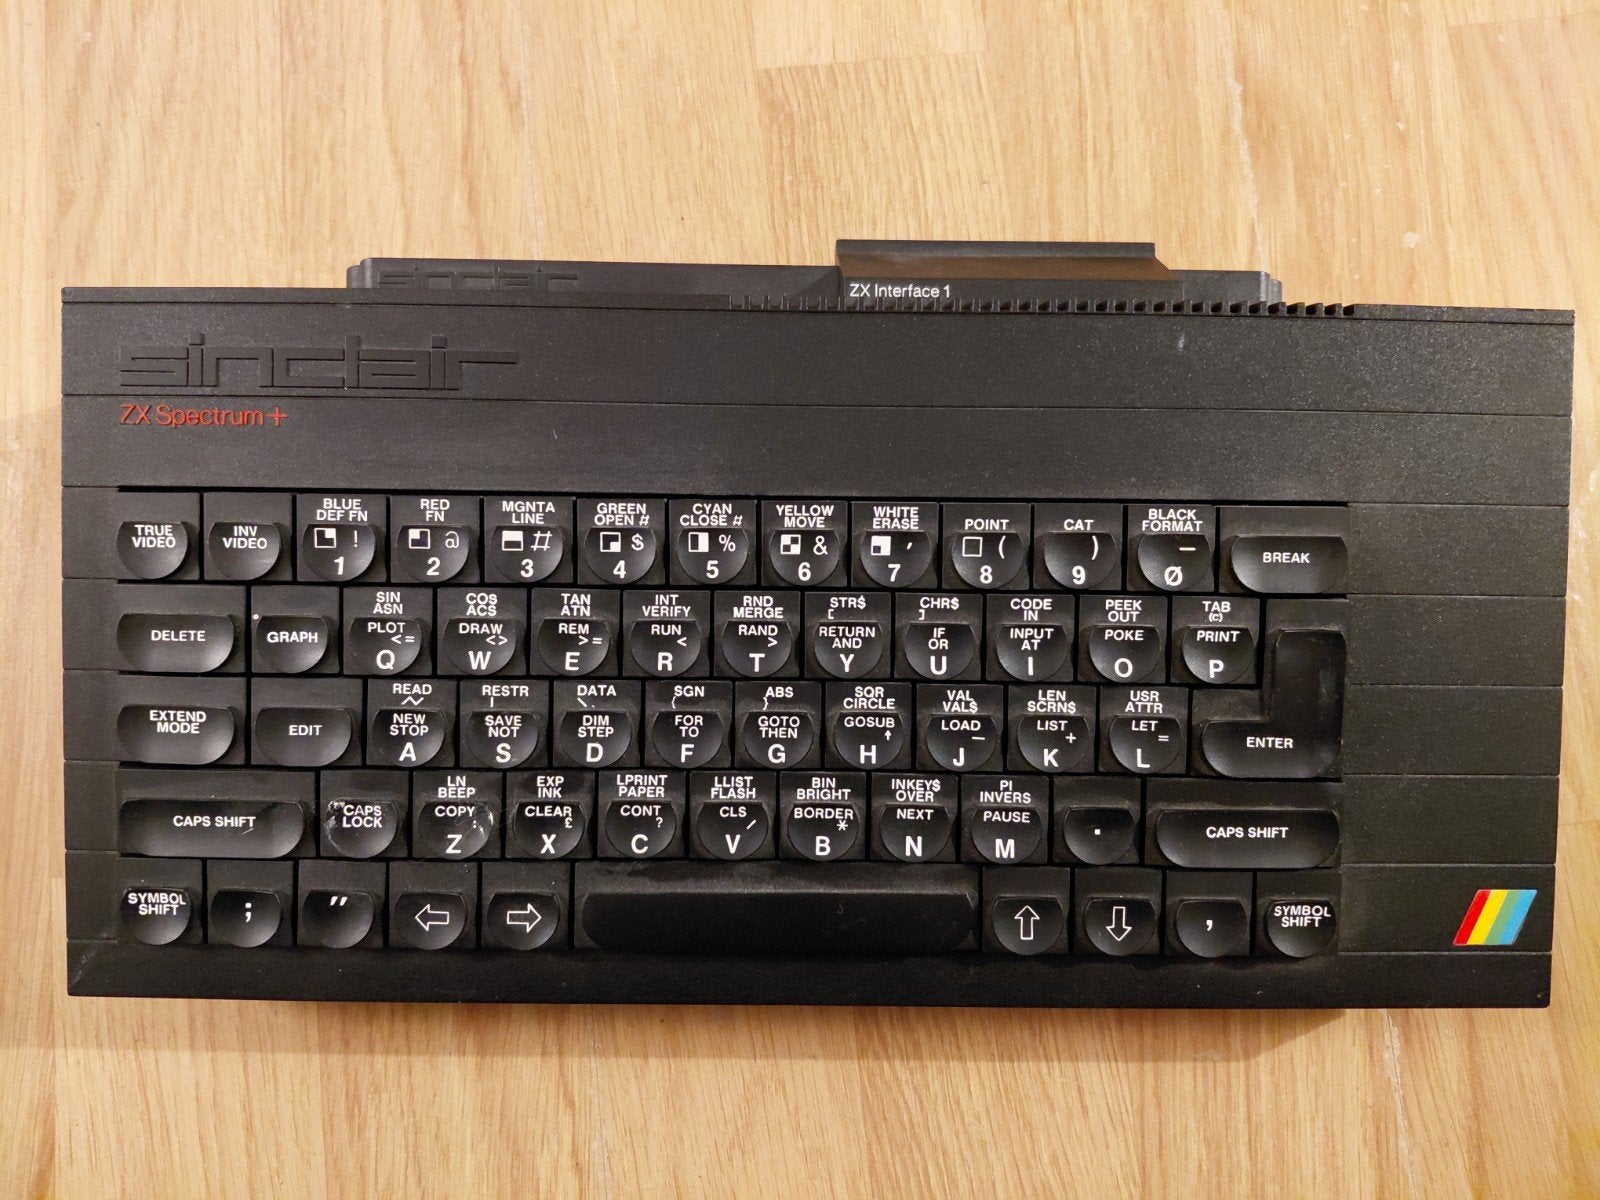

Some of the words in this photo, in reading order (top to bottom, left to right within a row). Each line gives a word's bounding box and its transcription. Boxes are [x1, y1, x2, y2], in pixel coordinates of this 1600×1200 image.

[850, 284, 870, 297] ZX
[875, 284, 939, 297] Interface
[944, 285, 949, 297] 1
[119, 334, 517, 389] sinclair
[121, 404, 150, 424] ZX
[157, 405, 264, 426] Spectrum
[324, 498, 361, 510] BLUE
[421, 499, 450, 510] RED
[503, 501, 555, 512] MGNTA
[596, 503, 646, 515] GREEN
[317, 509, 346, 521] DEF
[349, 510, 367, 521] FN
[426, 510, 444, 521] FN
[693, 504, 731, 516] CYAN
[776, 505, 834, 518] YELLOW
[874, 506, 918, 519] WHITE
[1149, 509, 1196, 520] BLACK
[512, 513, 544, 524] LINE
[595, 513, 634, 525] OPEN
[680, 515, 727, 526] CLOSE
[784, 516, 825, 528] MOVE
[873, 517, 918, 529] ERASE
[965, 519, 1009, 530] POINT
[1064, 519, 1093, 530] CAT
[1142, 520, 1202, 531] FORMAT
[135, 525, 173, 537] TRUE
[234, 526, 257, 536] INV
[132, 535, 176, 548] VIDEO
[223, 538, 267, 549] VIDEO
[1263, 552, 1309, 563] BREAK
[335, 557, 344, 575] 1
[427, 557, 440, 575] 2
[521, 559, 533, 577] 3
[613, 560, 626, 578] 4
[707, 560, 718, 578] 5
[798, 562, 811, 581] 6
[888, 564, 900, 582] 7
[980, 565, 992, 583] 8
[1072, 566, 1085, 584] 9
[377, 592, 400, 602] SIN
[466, 593, 497, 606] COS
[561, 594, 590, 606] TAN
[656, 595, 678, 605] INT
[744, 596, 773, 608] RND
[830, 595, 866, 609] STR$
[373, 603, 402, 614] ASN
[920, 597, 959, 610] CHR$
[1011, 598, 1052, 610] CODE
[1106, 600, 1141, 610] PEEK
[1202, 601, 1230, 612] TAB
[467, 604, 497, 616] ACS
[561, 604, 590, 616] ATN
[642, 606, 690, 617] VERIFY
[734, 607, 783, 618] MERGE
[1024, 610, 1038, 620] IN
[1108, 611, 1139, 622] OUT
[368, 622, 405, 633] PLOT
[459, 623, 502, 634] DRAW
[559, 623, 589, 634] REM
[652, 625, 681, 635] RUN
[739, 625, 778, 636] RAND
[820, 626, 875, 637] RETURN
[934, 628, 945, 638] IF
[151, 630, 205, 641] DELETE
[267, 632, 318, 643] GRAPH
[1010, 628, 1054, 639] INPUT
[1105, 630, 1143, 640] POKE
[1197, 631, 1240, 642] PRINT
[832, 638, 862, 648] AND
[929, 639, 948, 649] OR
[1022, 640, 1040, 650] AT
[377, 650, 395, 669] Q
[469, 651, 491, 670] W
[565, 652, 580, 670] E
[658, 652, 672, 671] R
[749, 654, 765, 672] T
[1209, 660, 1224, 678] P
[393, 683, 432, 694] READ
[482, 685, 528, 696] RESTR
[578, 685, 616, 696] DATA
[673, 686, 704, 698] SGN
[764, 687, 793, 699] ABS
[855, 686, 884, 697] SQR
[947, 690, 975, 702] VAL
[1038, 690, 1066, 702] LEN
[1131, 690, 1159, 702] USR
[844, 698, 895, 709] CIRCLE
[943, 700, 978, 714] VAL$
[1028, 701, 1076, 714] SCRN$
[1125, 702, 1162, 713] ATTR
[150, 710, 206, 723] EXTEND
[394, 713, 425, 724] NEW
[485, 715, 521, 726] SAVE
[583, 715, 609, 726] DIM
[675, 715, 703, 725] FOR
[758, 716, 800, 728] GOTO
[157, 722, 199, 733] MODE
[844, 717, 894, 728] GOSUB
[942, 720, 980, 731] LOAD
[1037, 720, 1067, 730] LIST
[1132, 720, 1158, 731] LET
[289, 725, 322, 735] EDIT
[390, 725, 428, 736] STOP
[489, 727, 519, 737] NOT
[578, 727, 613, 737] STEP
[680, 726, 699, 737] TO
[759, 726, 797, 738] THEN
[1247, 737, 1293, 748] ENTER
[399, 742, 416, 761] A
[496, 743, 511, 762] S
[681, 744, 694, 762] F
[768, 744, 785, 763] G
[860, 745, 876, 764] H
[448, 776, 466, 786] LN
[537, 776, 564, 786] EXP
[617, 775, 667, 785] LPRINT
[715, 776, 753, 789] LLIST
[812, 777, 835, 788] BIN
[1000, 780, 1012, 791] PI
[619, 786, 664, 797] PAPER
[892, 779, 940, 793] INKEY$
[438, 787, 475, 798] BEEP
[538, 787, 561, 798] INK
[711, 787, 755, 799] FLASH
[797, 789, 851, 800] BRIGHT
[896, 790, 933, 802] OVER
[980, 792, 1031, 803] INVERS
[344, 805, 382, 816] CAPS
[435, 806, 475, 817] COPY
[525, 806, 572, 819] CLEAR
[621, 805, 661, 816] CONT
[720, 806, 746, 817] CLS
[794, 807, 853, 819] BORDER
[897, 809, 933, 820] NEXT
[173, 816, 211, 827] CAPS
[215, 816, 256, 827] SHIFT
[343, 816, 382, 828] LOCK
[984, 811, 1030, 823] PAUSE
[1206, 827, 1244, 838] CAPS
[1248, 827, 1288, 838] SHIFT
[446, 835, 462, 853] Z
[632, 834, 648, 853] C
[816, 836, 830, 855] B
[906, 836, 922, 856] N
[996, 839, 1014, 858] M
[129, 893, 186, 907] SYMBOL
[139, 903, 179, 915] SHIFT
[1274, 905, 1331, 917] SYMBOL
[1282, 916, 1321, 927] SHIFT
